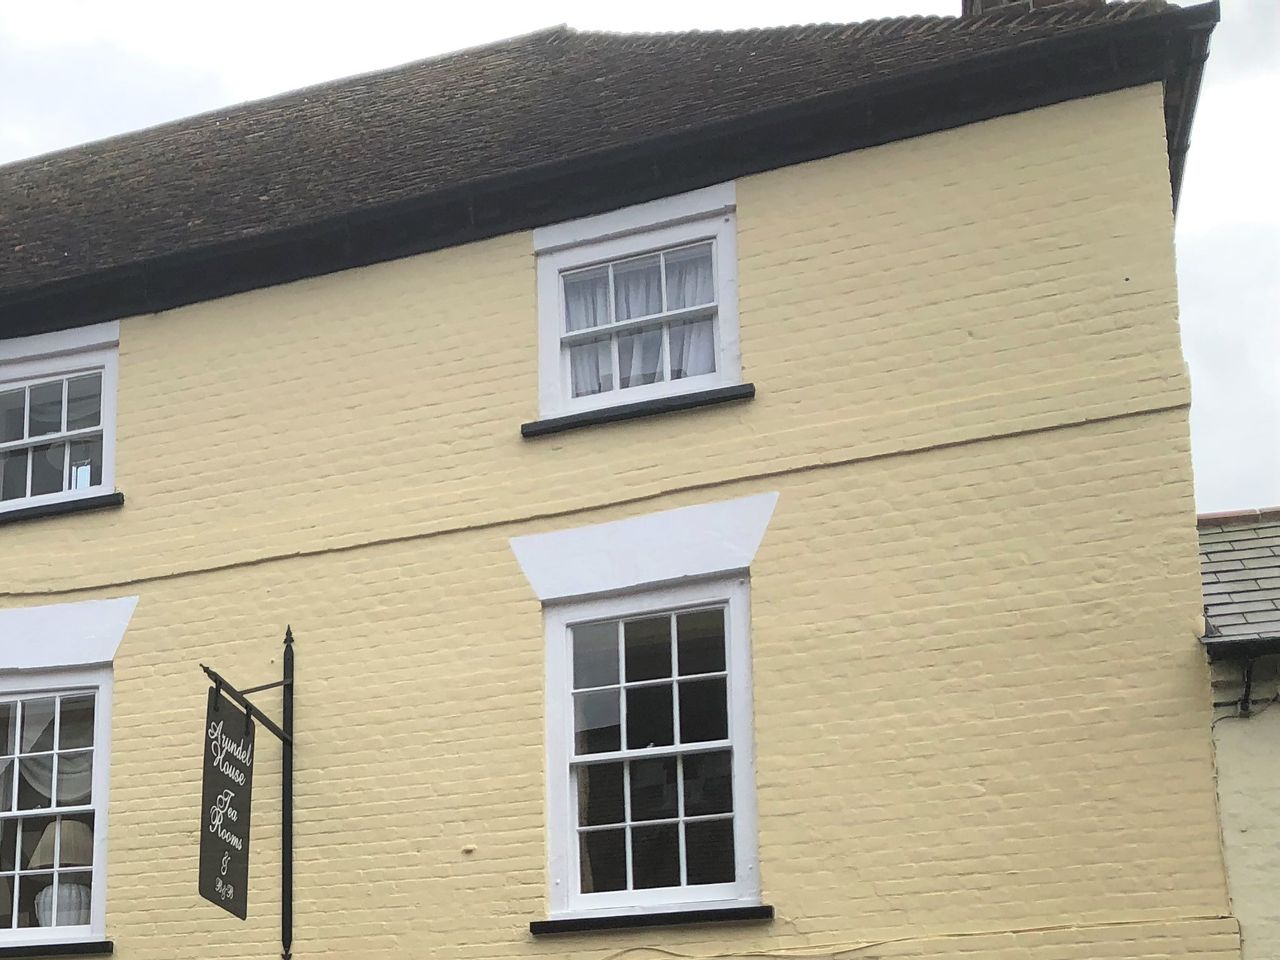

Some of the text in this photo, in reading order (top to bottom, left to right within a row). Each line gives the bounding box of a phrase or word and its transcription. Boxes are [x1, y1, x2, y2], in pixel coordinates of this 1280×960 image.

[208, 720, 252, 767] Arundel
[211, 740, 246, 786] House
[209, 805, 242, 850] Rooms
[217, 789, 238, 822] Tea
[221, 851, 231, 875] &
